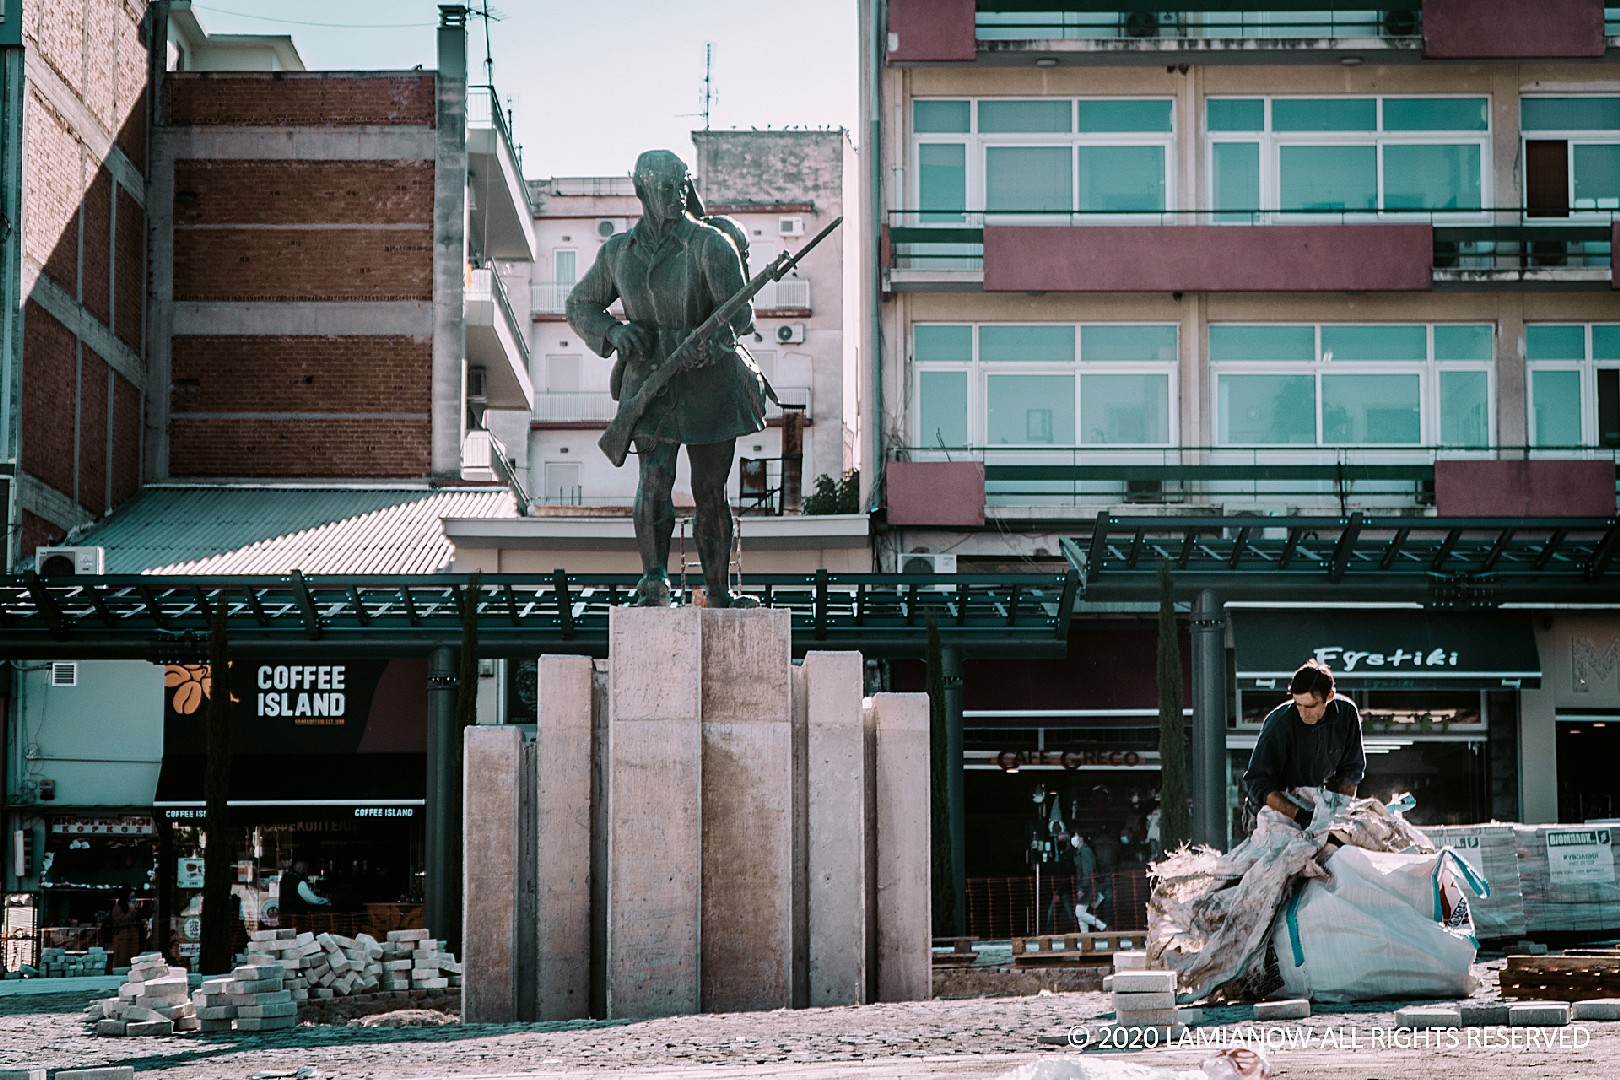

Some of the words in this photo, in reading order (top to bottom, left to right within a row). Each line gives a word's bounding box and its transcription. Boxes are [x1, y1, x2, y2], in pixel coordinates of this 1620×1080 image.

[257, 665, 346, 690] COFFEE
[257, 692, 346, 717] ISLAND
[1061, 750, 1140, 770] GRECO
[165, 810, 194, 818] COFFEE
[355, 808, 383, 817] COFFEE
[384, 808, 413, 817] ISLAND
